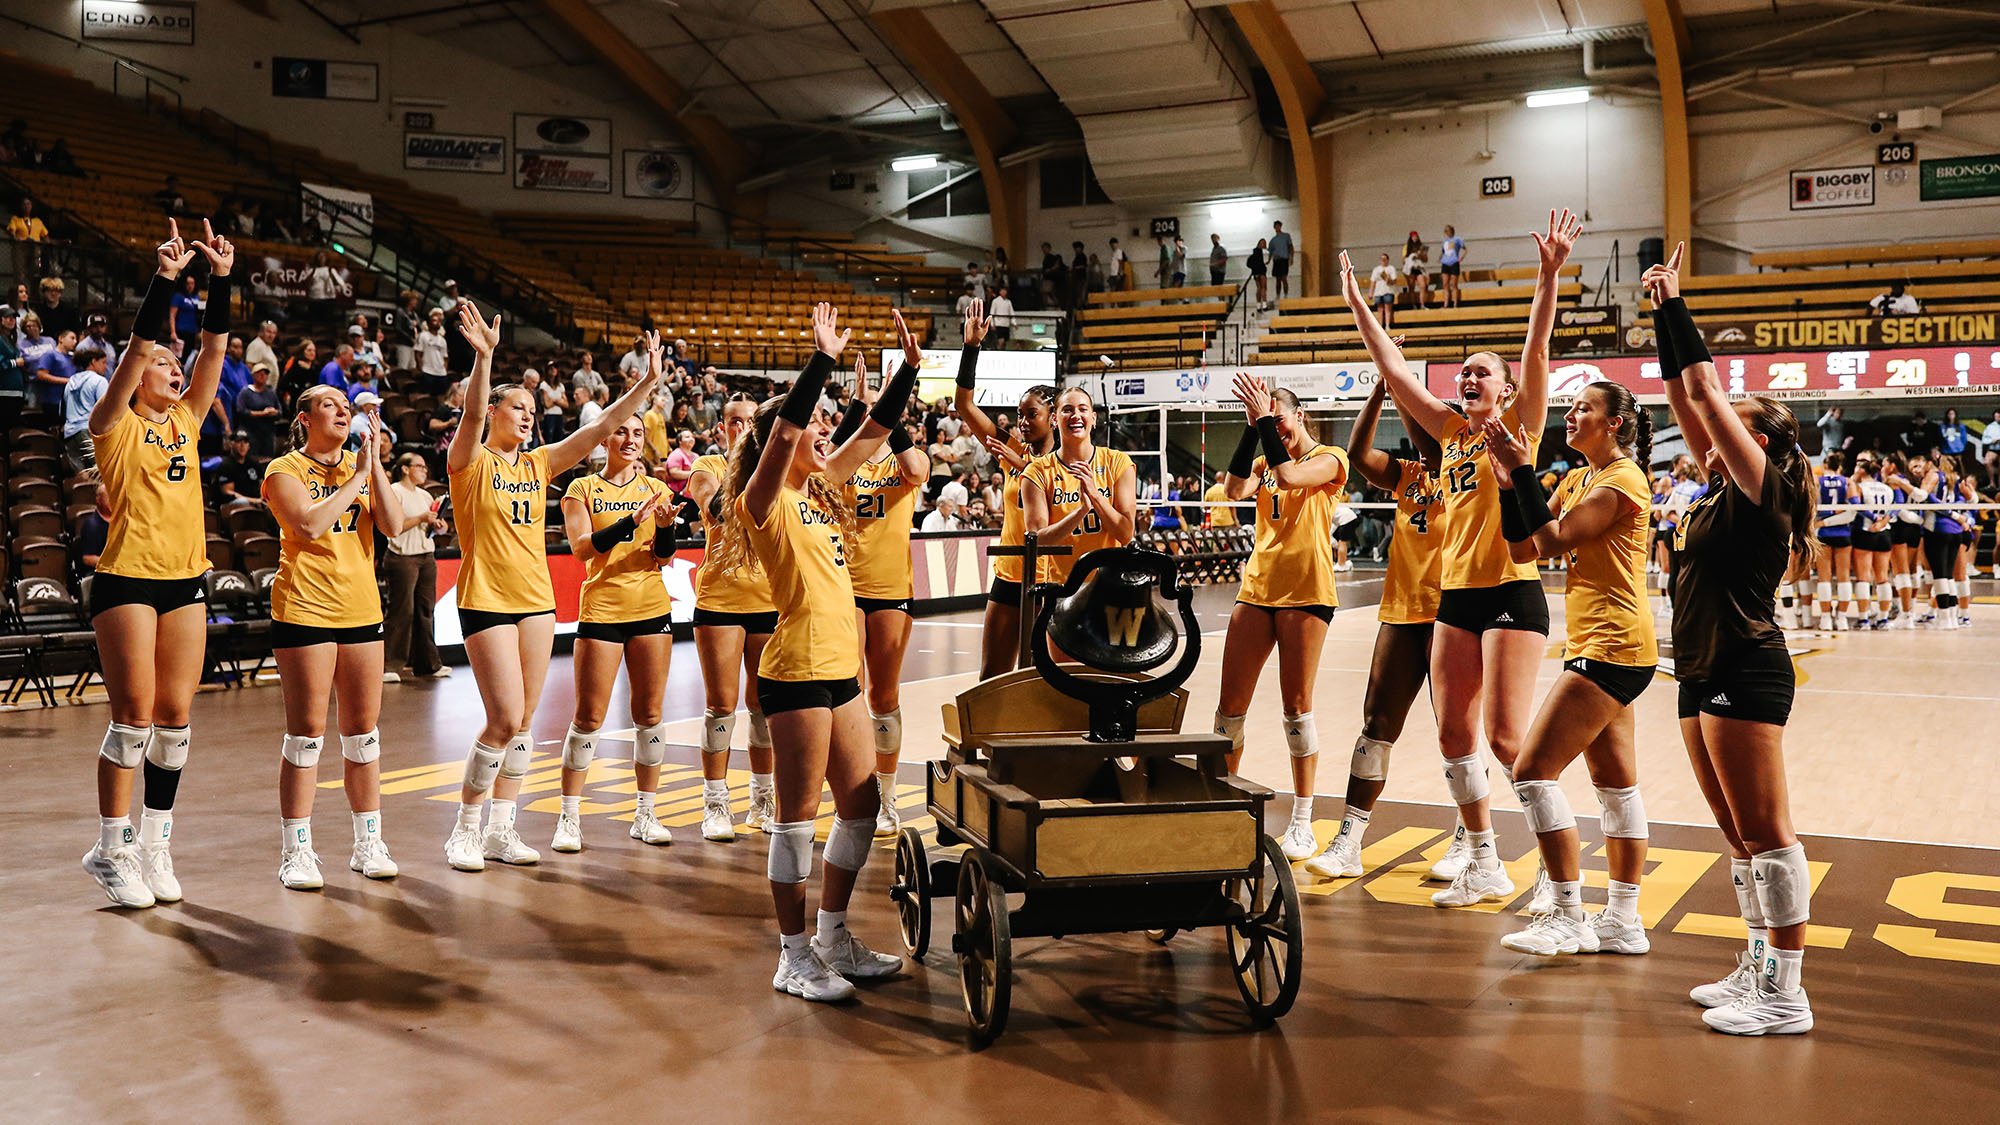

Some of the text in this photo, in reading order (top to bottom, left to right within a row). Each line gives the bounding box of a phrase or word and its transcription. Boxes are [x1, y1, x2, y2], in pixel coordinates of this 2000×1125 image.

[87, 11, 190, 28] CONDADO
[519, 154, 568, 172] PENN
[1882, 147, 1911, 161] 206
[1485, 178, 1510, 194] 205
[1816, 173, 1870, 187] BIGGBY
[1816, 188, 1870, 201] COFFEE
[1154, 218, 1176, 234] 204
[385, 312, 394, 325] C
[1553, 325, 1616, 337] STUDENT SECTION
[1754, 314, 1996, 348] STUDENT SECTION
[1826, 351, 1870, 375] SET
[1768, 362, 1808, 389] 25
[1885, 359, 1927, 387] 20
[1790, 391, 1827, 399] BRONCOS
[1905, 386, 1945, 395] WESTERN
[1948, 384, 1989, 394] MICHIGAN
[167, 455, 187, 482] 6
[1448, 460, 1478, 494] 12
[511, 500, 532, 525] 11
[855, 493, 887, 520] 21
[1271, 494, 1281, 521] 1
[1409, 509, 1429, 535] 4
[1104, 606, 1147, 648] W
[1711, 697, 1732, 706] adidas
